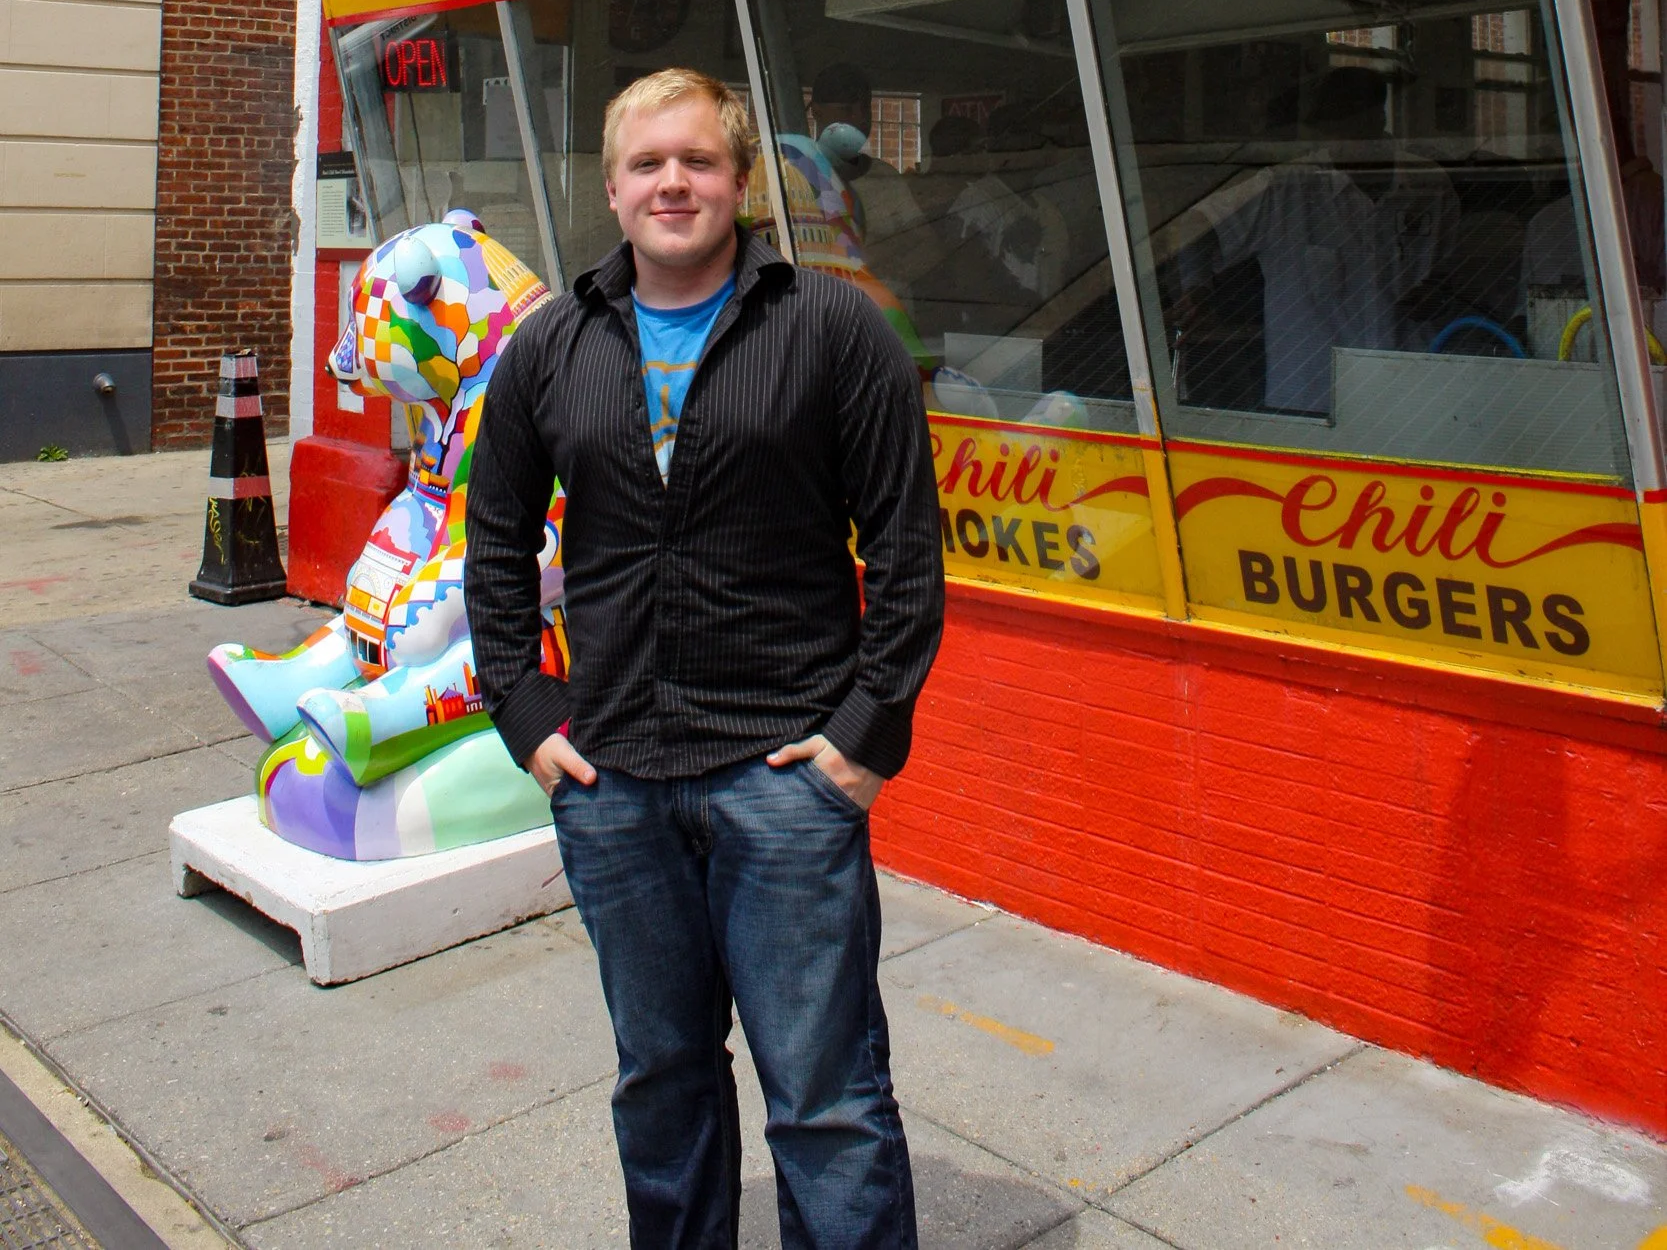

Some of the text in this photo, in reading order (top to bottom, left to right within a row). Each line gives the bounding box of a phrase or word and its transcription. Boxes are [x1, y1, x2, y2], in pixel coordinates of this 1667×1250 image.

[385, 39, 447, 88] OPEN
[1281, 475, 1522, 569] Chili
[1238, 549, 1591, 657] BURGERS
